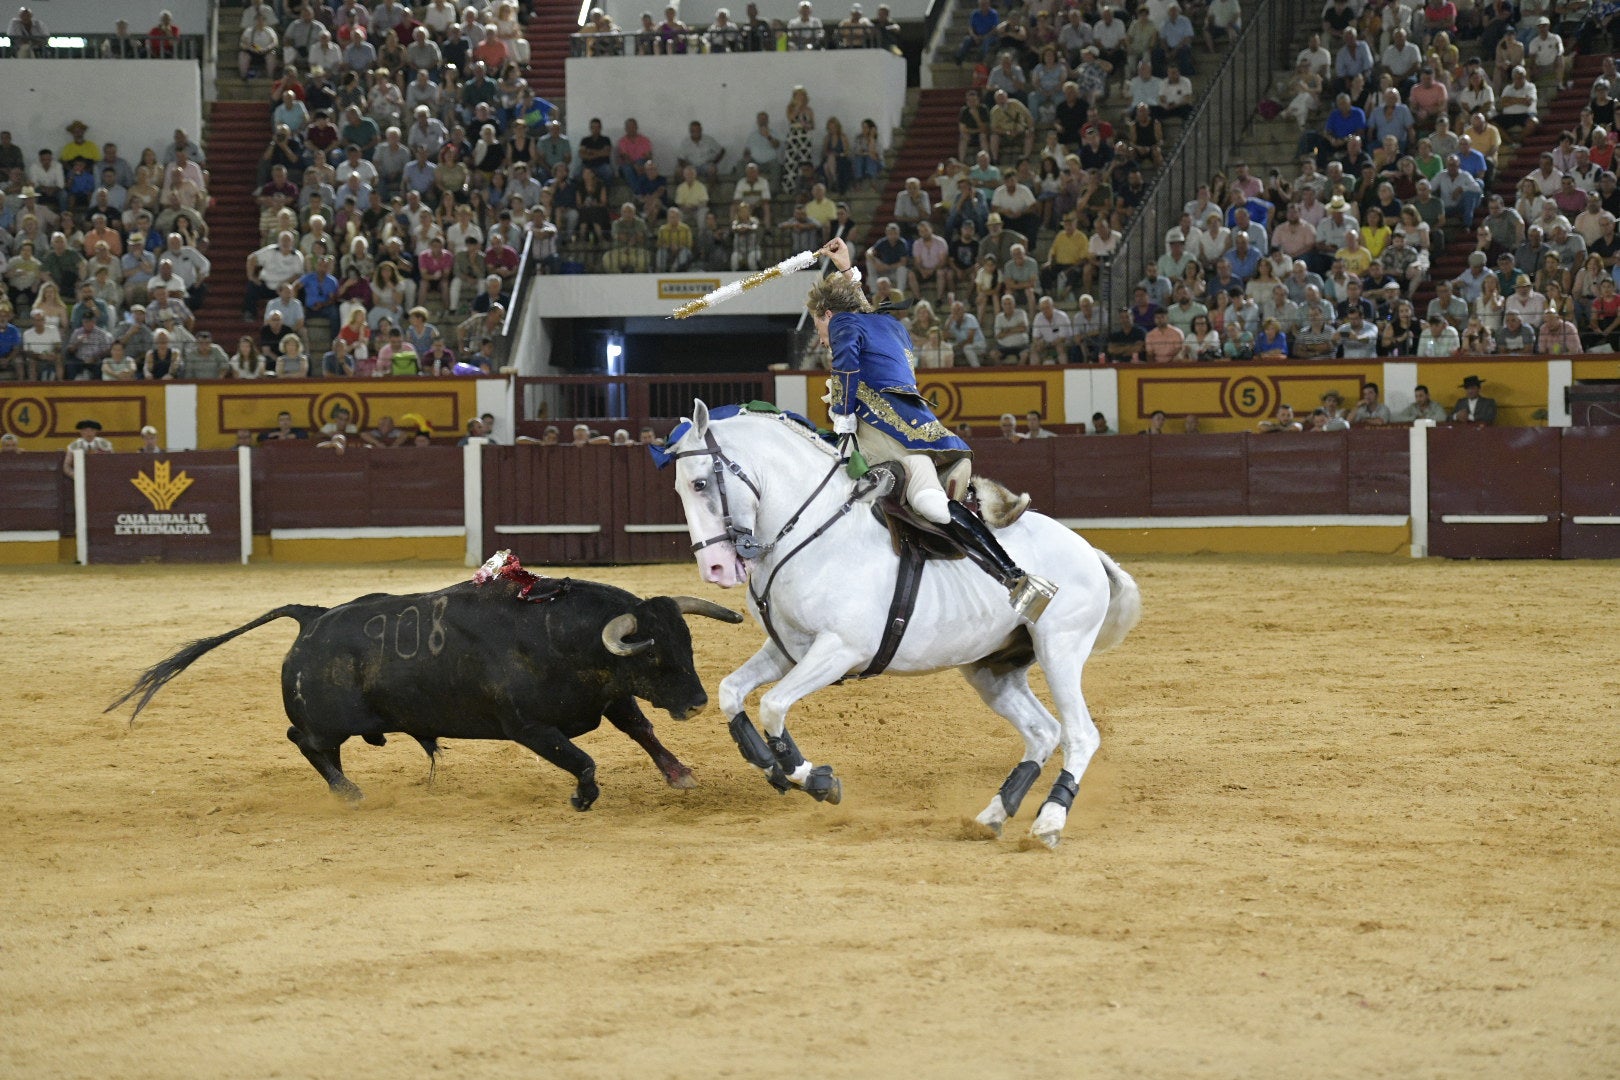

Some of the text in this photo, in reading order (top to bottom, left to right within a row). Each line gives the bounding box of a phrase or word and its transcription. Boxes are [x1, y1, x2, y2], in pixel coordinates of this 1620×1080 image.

[1242, 388, 1257, 407] 5
[18, 406, 31, 426] 4
[117, 513, 207, 524] CAJA RURAL DE
[114, 524, 210, 535] EXTREMADURA
[363, 595, 448, 661] 908
